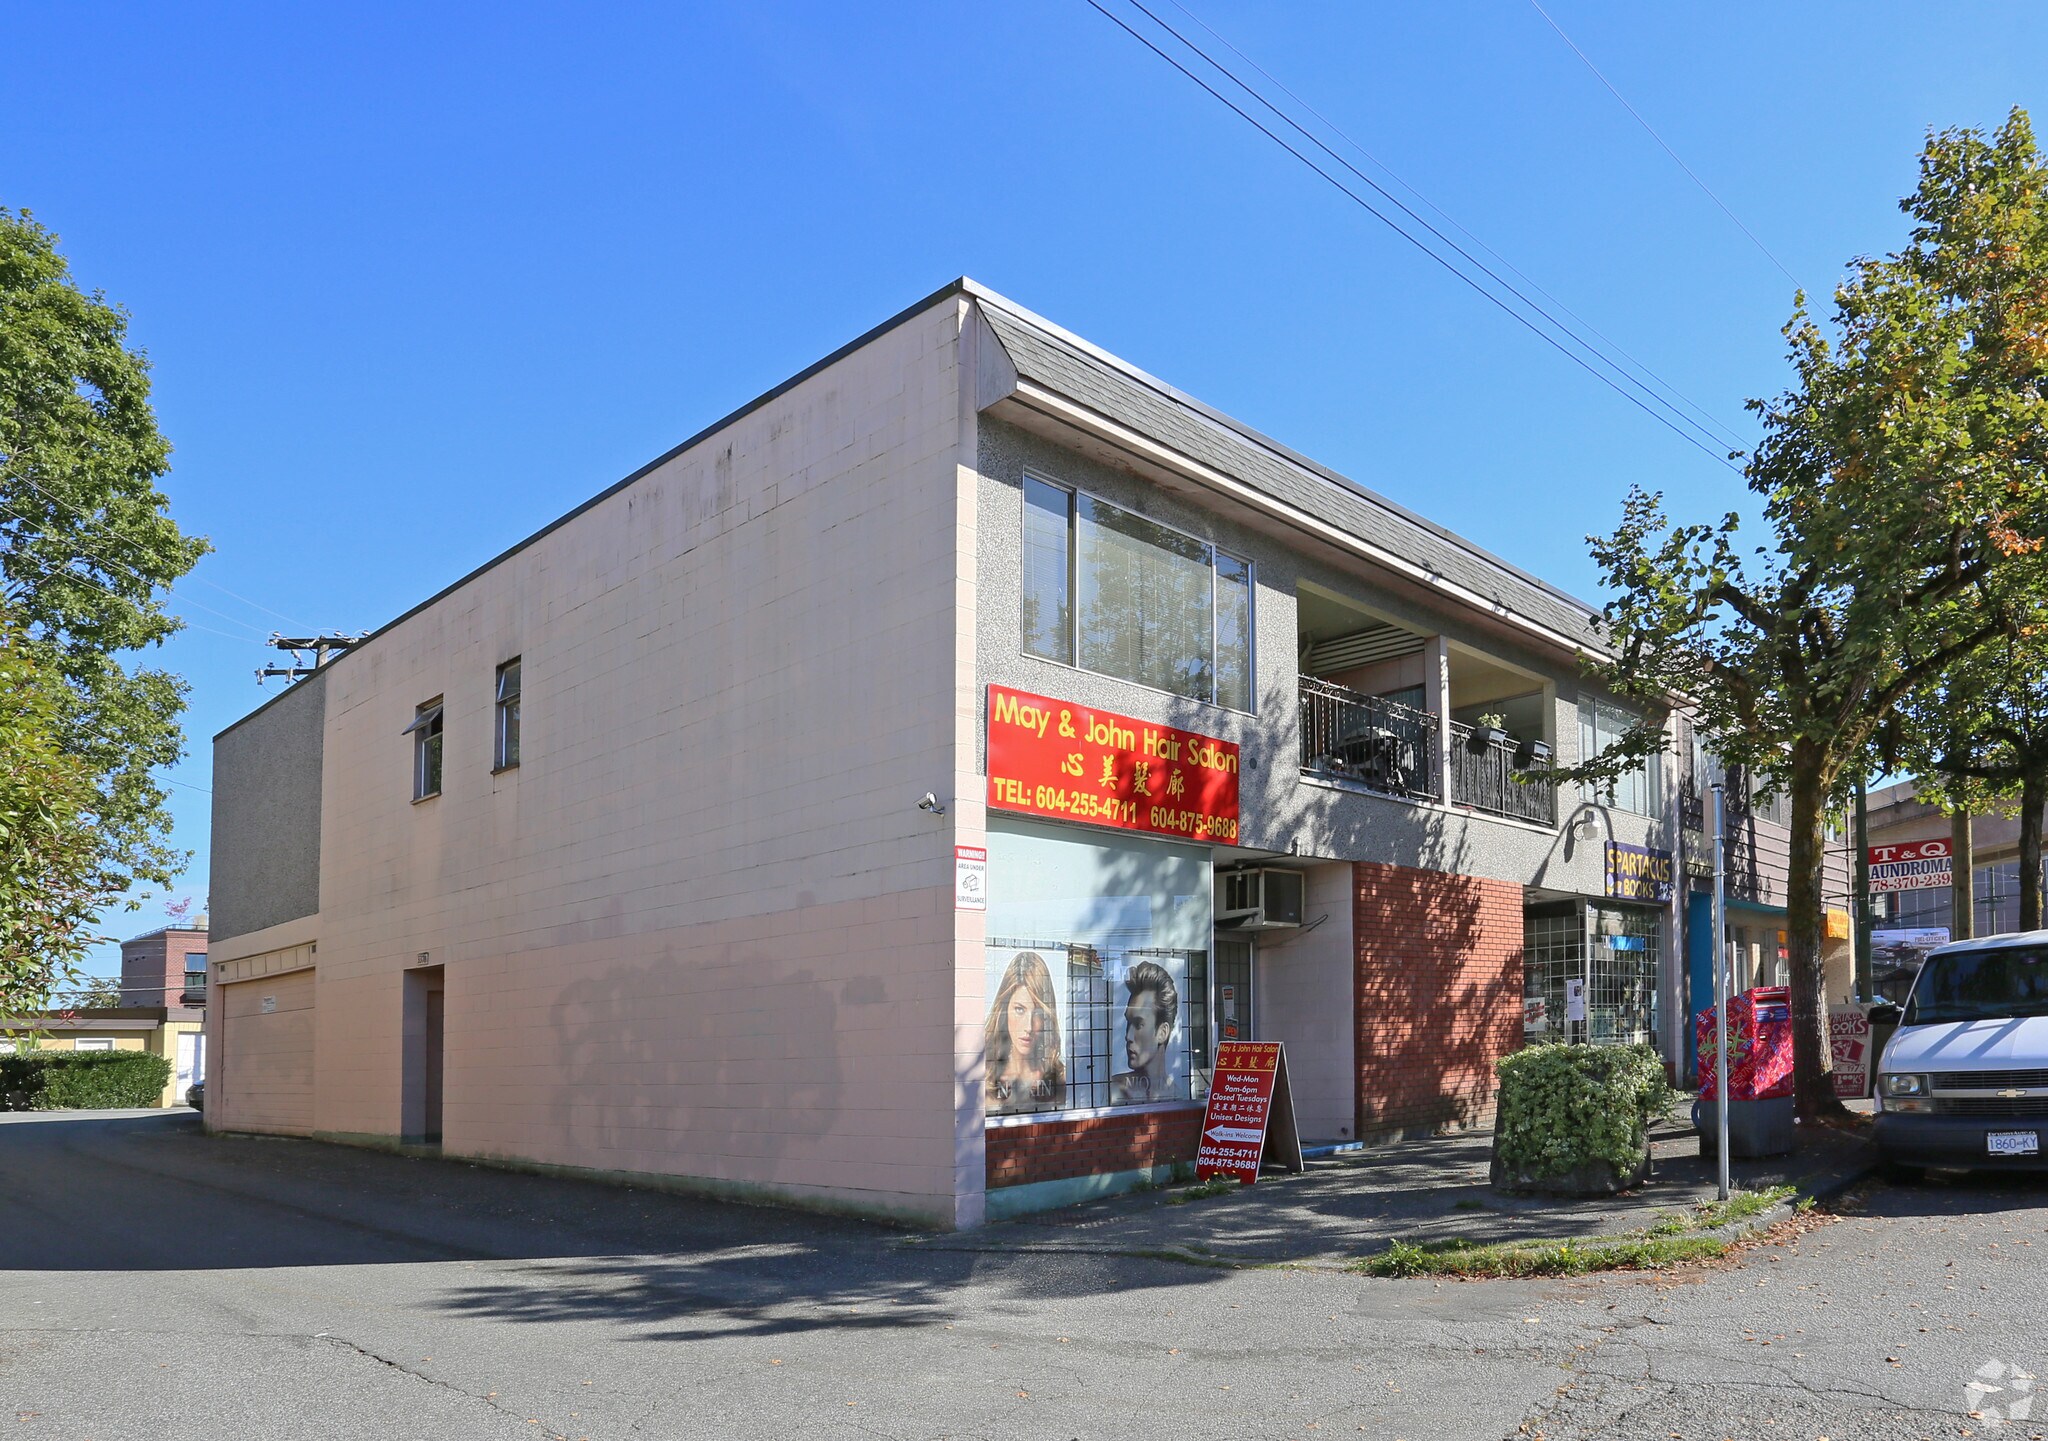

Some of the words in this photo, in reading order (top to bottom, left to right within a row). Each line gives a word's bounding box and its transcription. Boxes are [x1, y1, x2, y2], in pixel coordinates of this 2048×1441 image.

[994, 693, 1051, 738] May
[1058, 709, 1076, 738] &
[1084, 715, 1135, 752] John
[1143, 728, 1181, 761] Hair
[1188, 738, 1237, 774] Salon
[993, 777, 1032, 806] TEL:
[1035, 784, 1137, 824] 604-255-4711
[1150, 805, 1237, 839] 604-875-9688
[1874, 846, 1897, 862] T
[1900, 850, 1916, 859] &
[1920, 842, 1948, 857] Q
[1608, 848, 1670, 882] SPARTACUS
[1869, 858, 1953, 879] AUNDROMA
[1623, 878, 1655, 899] BOOKS
[1868, 873, 1953, 892] 78-370-239
[956, 895, 985, 904] SURVEILLANCE
[1831, 1019, 1868, 1034] OOKS
[1232, 1045, 1237, 1053] &
[1237, 1045, 1251, 1053] John
[1252, 1045, 1262, 1053] Hair
[1263, 1045, 1279, 1053] Salon
[1226, 1074, 1259, 1083] Wed-Mon
[1224, 1085, 1258, 1094] 9am-6pm
[1212, 1093, 1236, 1101] Closed
[1237, 1094, 1268, 1103] Tuesdays
[1234, 1114, 1262, 1124] Designs
[1210, 1130, 1234, 1138] Walk-ins
[1235, 1131, 1261, 1140] Welcome
[1200, 1146, 1258, 1159] 604-255-4711
[1198, 1157, 1257, 1170] 604-875-9688
